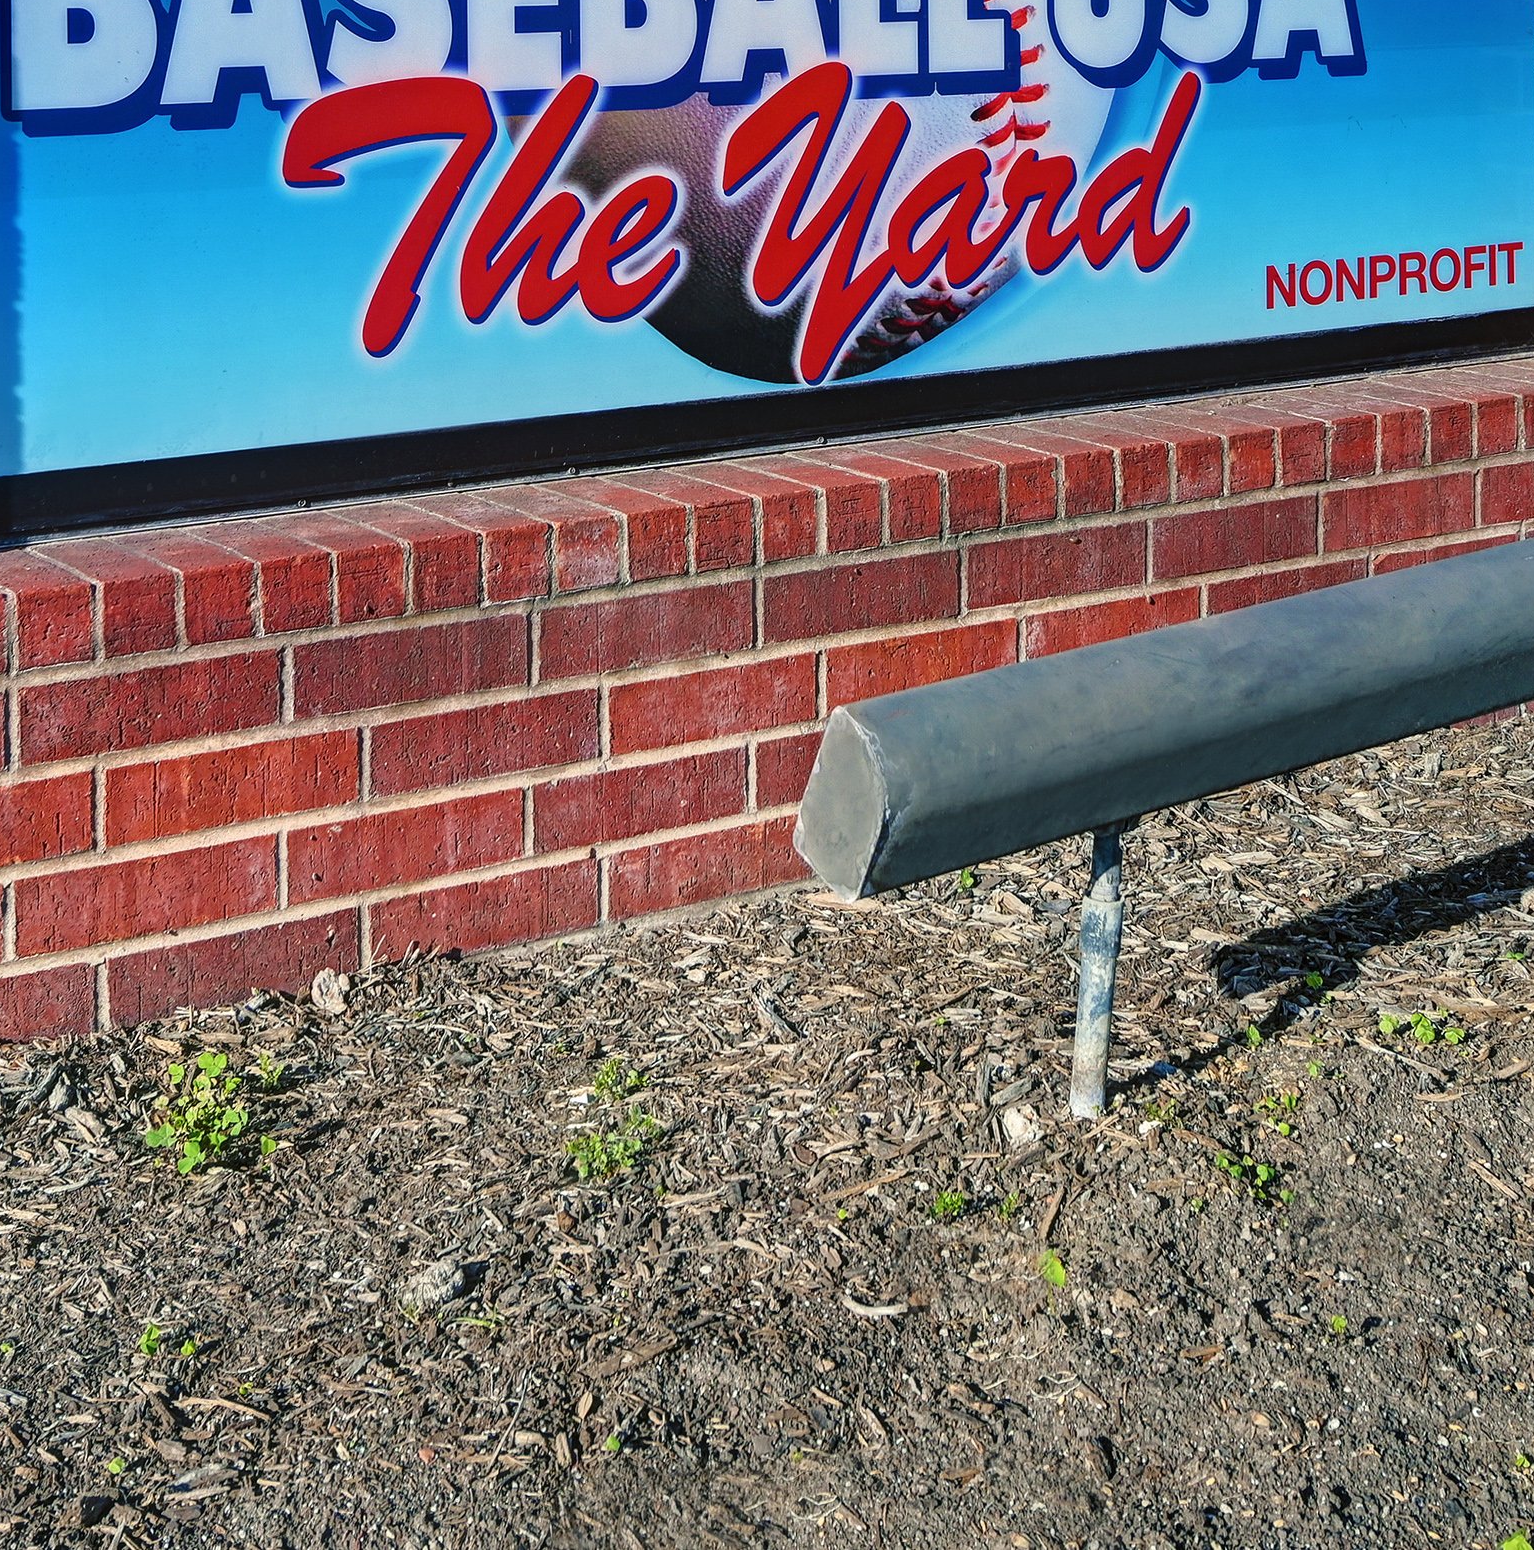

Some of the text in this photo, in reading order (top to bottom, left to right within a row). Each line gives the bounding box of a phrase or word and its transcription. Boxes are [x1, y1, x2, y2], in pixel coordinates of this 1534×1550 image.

[281, 70, 1203, 386] The Yard
[1265, 241, 1525, 311] NONPROFIT
